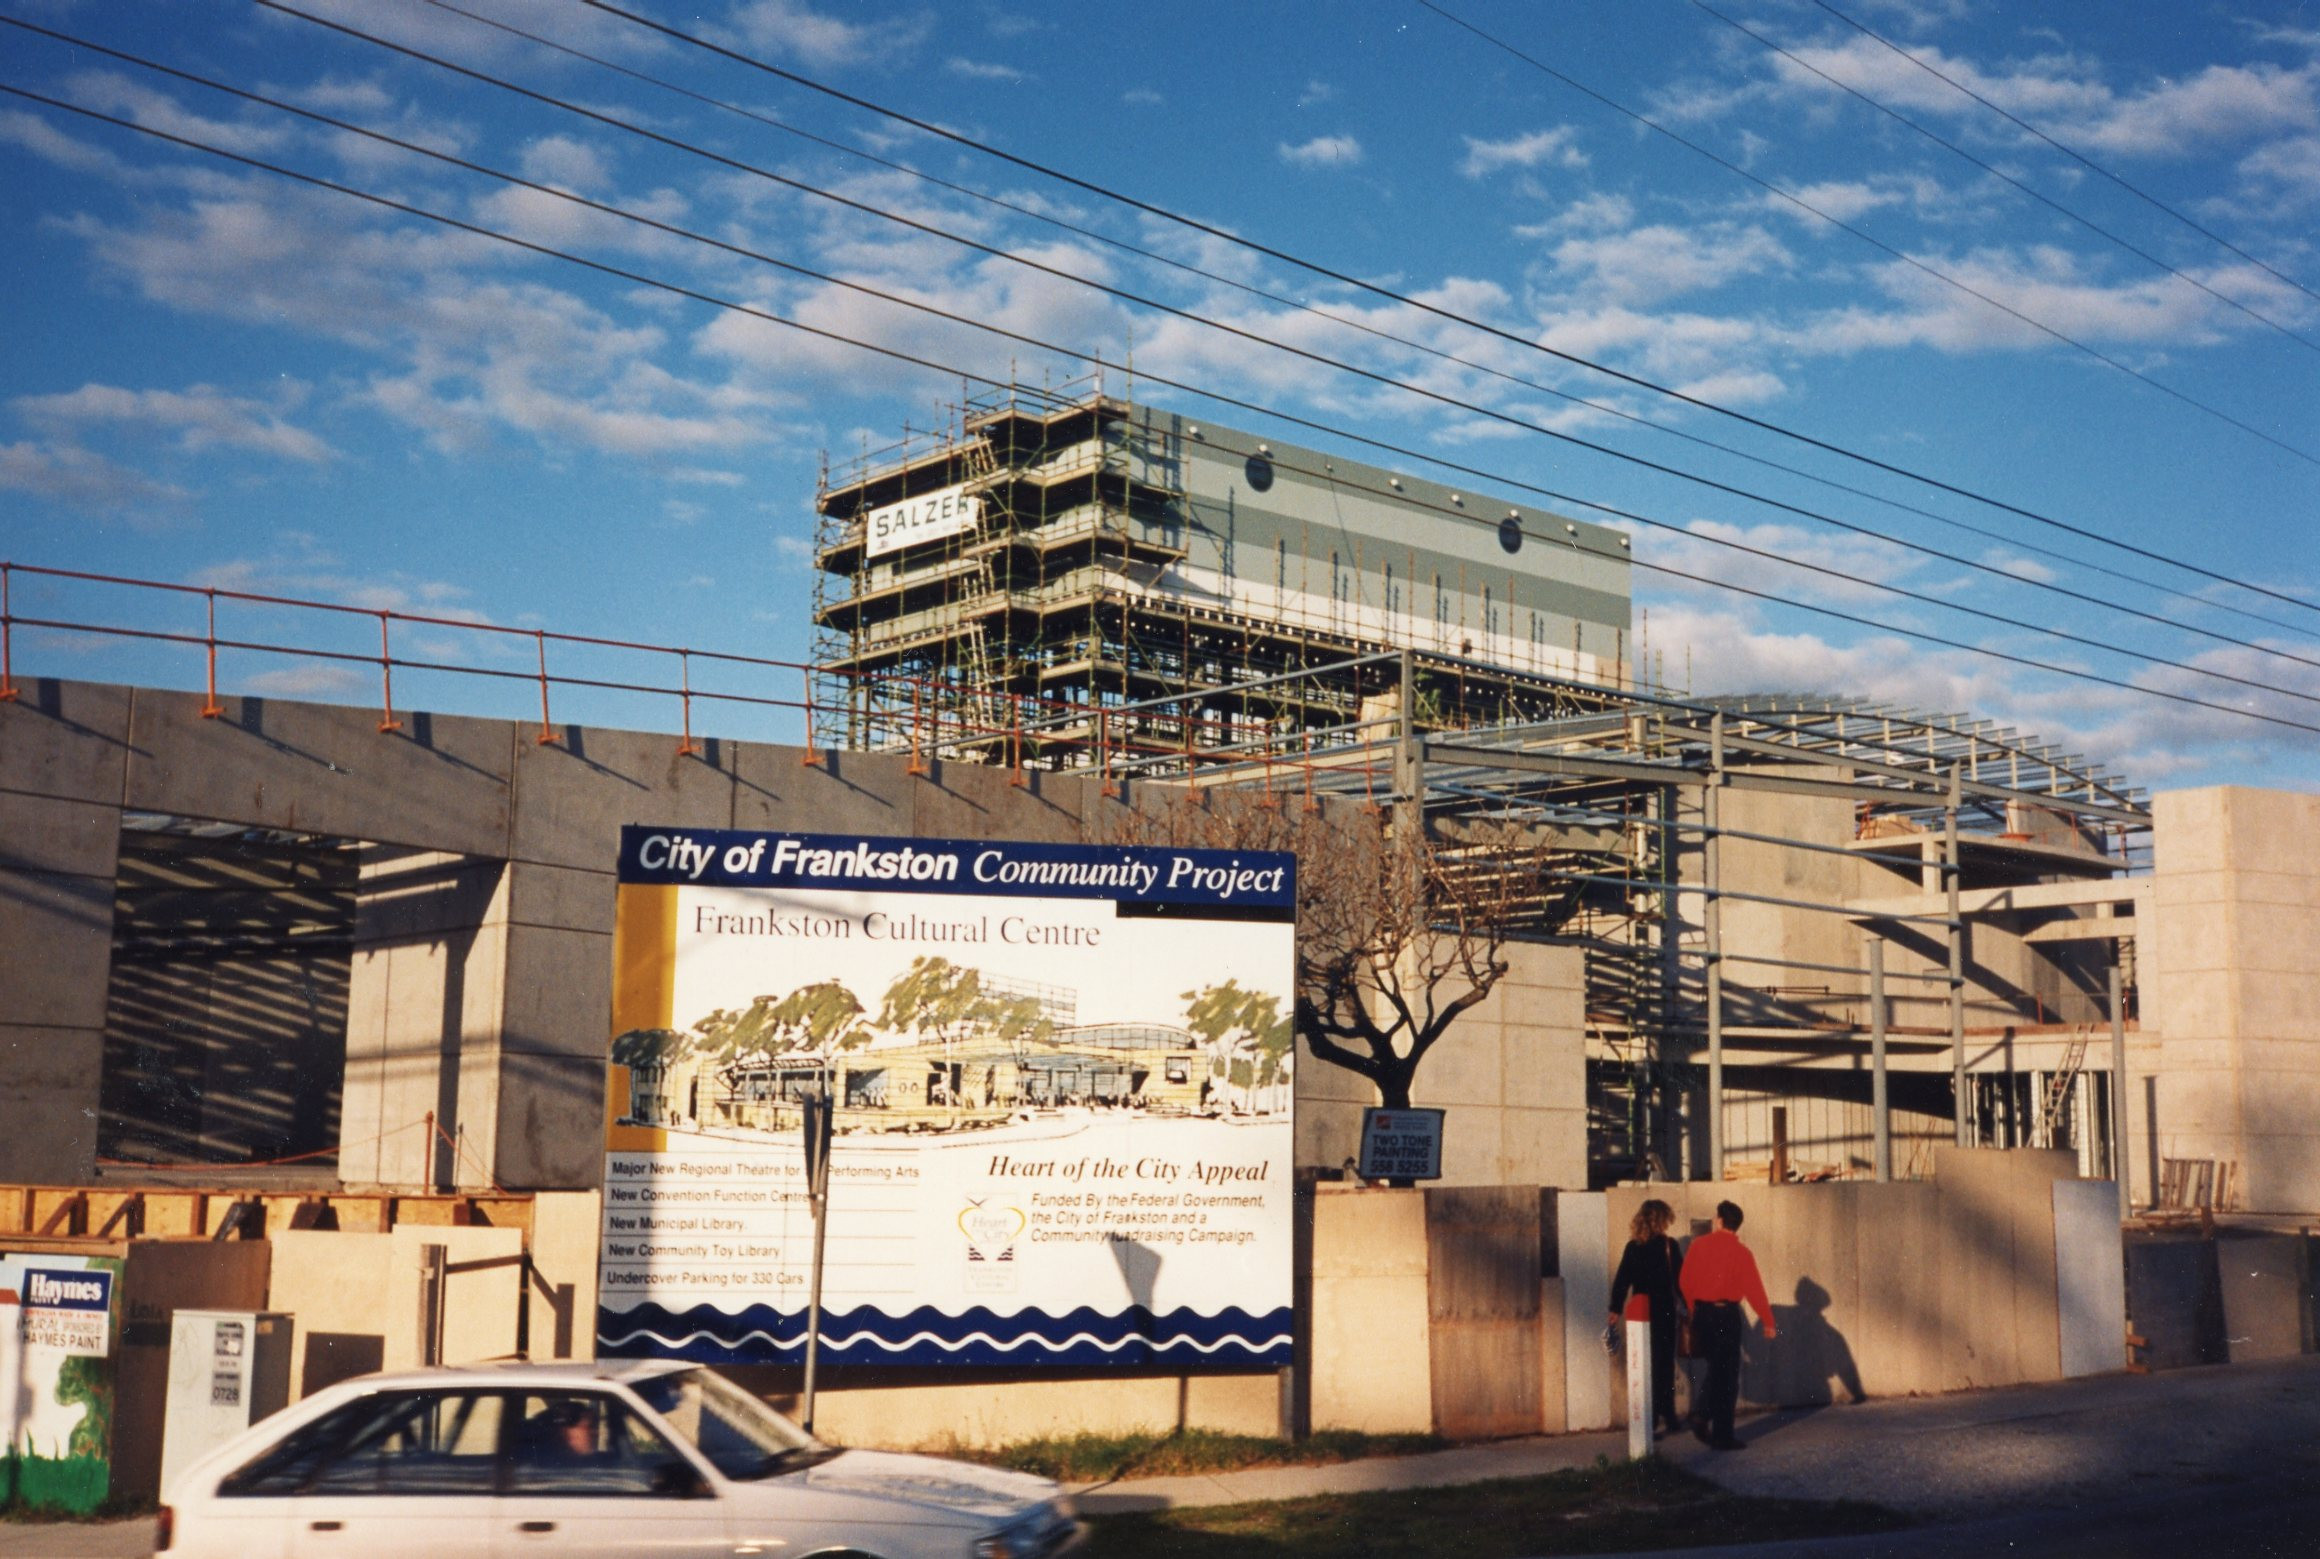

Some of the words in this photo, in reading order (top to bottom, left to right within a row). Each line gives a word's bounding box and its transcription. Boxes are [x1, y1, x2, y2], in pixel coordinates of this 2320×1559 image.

[639, 835, 716, 879] City
[723, 839, 767, 874] of
[771, 840, 959, 881] Frankston
[973, 850, 1158, 895] Community
[1166, 857, 1284, 899] Project
[695, 906, 850, 939] Frankston
[863, 912, 987, 943] Cultural
[1000, 917, 1101, 946] Centre
[612, 1162, 646, 1177] Major
[650, 1163, 674, 1174] New
[680, 1163, 732, 1177] Regional
[737, 1163, 780, 1175] Theatre
[785, 1164, 801, 1176] for
[828, 1165, 891, 1180] Performing
[896, 1167, 920, 1178] Arts
[988, 1155, 1055, 1177] Heart
[1063, 1157, 1090, 1182] of
[1093, 1157, 1128, 1178] the
[1136, 1158, 1180, 1183] City
[1187, 1160, 1269, 1185] Appeal
[611, 1188, 637, 1201] New
[641, 1188, 710, 1201] Convention
[714, 1190, 766, 1201] Function
[1032, 1193, 1081, 1207] Funded
[1086, 1193, 1102, 1210] By
[1107, 1193, 1127, 1207] the
[1130, 1193, 1178, 1207] Federal
[1183, 1193, 1265, 1209] Government,
[610, 1217, 636, 1229] New
[640, 1216, 698, 1232] Municipal
[1031, 1212, 1051, 1224] the
[1056, 1211, 1081, 1226] City
[1086, 1211, 1099, 1224] of
[1103, 1211, 1170, 1224] Frankston
[1172, 1212, 1195, 1224] and
[1200, 1214, 1207, 1224] a
[1031, 1229, 1108, 1244] Community
[1189, 1229, 1257, 1243] Campaign.
[609, 1244, 635, 1256] New
[638, 1244, 708, 1258] Community
[713, 1244, 733, 1259] Toy
[738, 1245, 780, 1259] Library
[607, 1271, 677, 1284] Undercover
[682, 1272, 728, 1286] Parking
[732, 1272, 748, 1284] for
[30, 1273, 102, 1305] Haymes
[24, 1332, 66, 1347] HAYMES
[70, 1334, 102, 1349] PAINT
